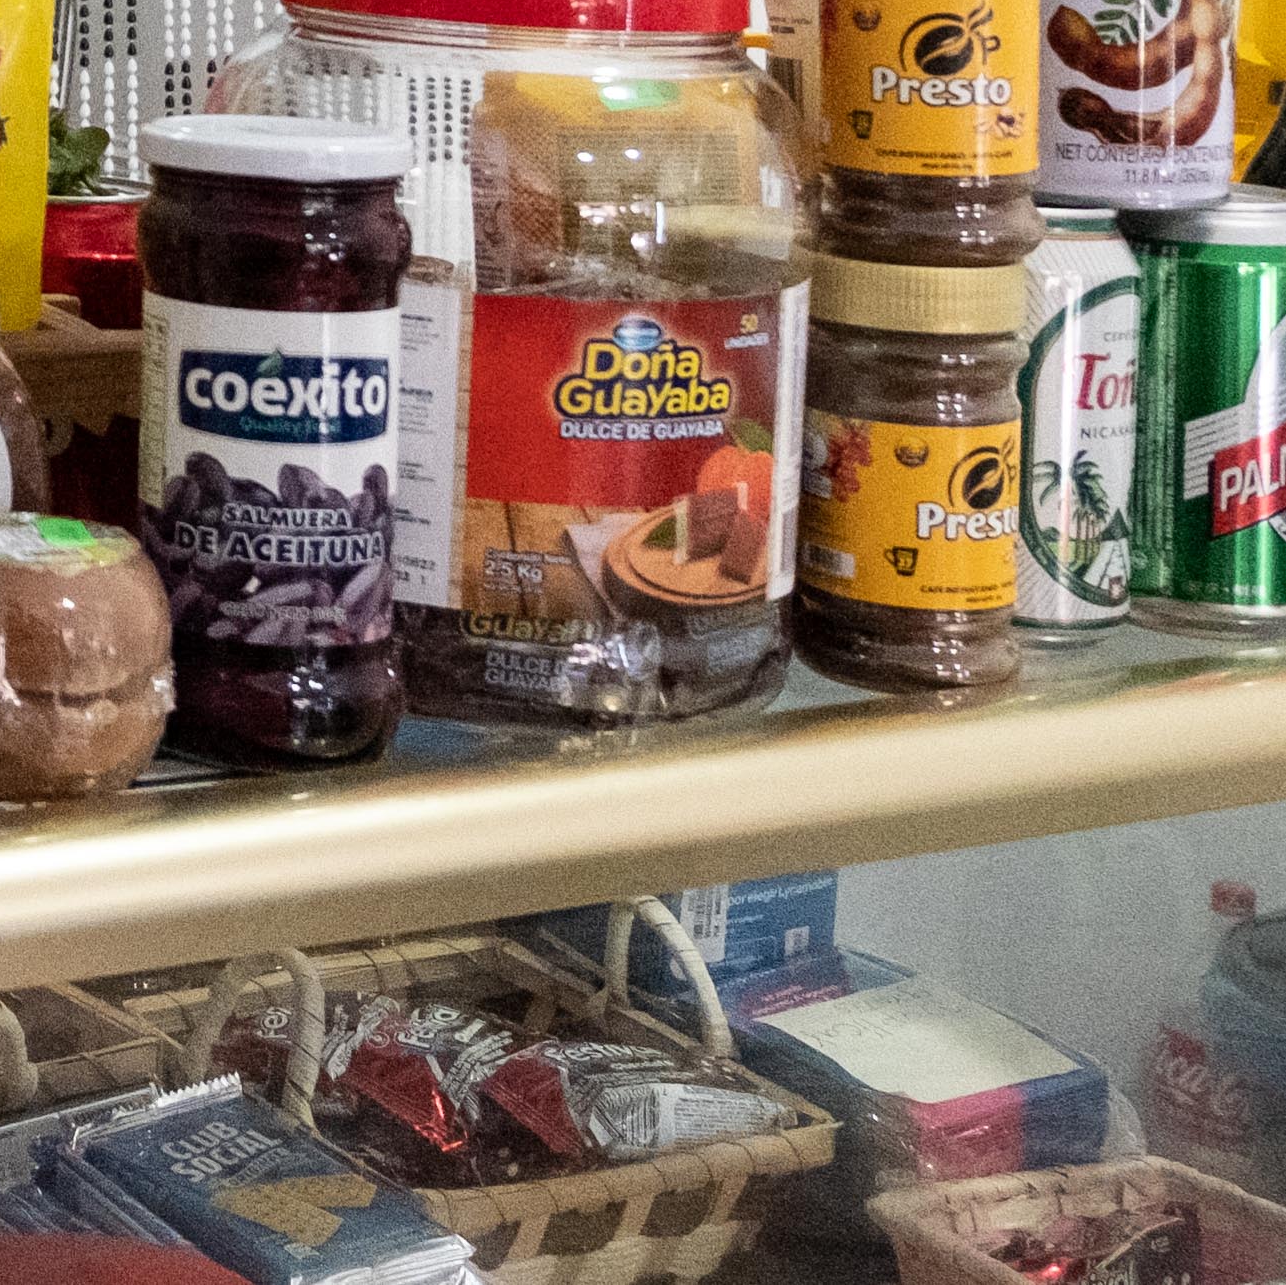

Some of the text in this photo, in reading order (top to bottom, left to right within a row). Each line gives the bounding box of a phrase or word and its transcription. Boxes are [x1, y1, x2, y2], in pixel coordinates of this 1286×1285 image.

[872, 66, 1013, 107] Presto
[1055, 143, 1082, 160] NET
[585, 342, 700, 381] Doña
[185, 362, 387, 418] coexito
[559, 378, 730, 417] Guayaba
[561, 420, 725, 441] DULCE DE GUAYABA
[1220, 443, 1286, 512] PAL
[223, 503, 353, 529] SALMUERA
[175, 521, 386, 566] DE ACEITUNA
[161, 1122, 239, 1160] CLUB
[171, 1128, 284, 1183] SOCIAL
